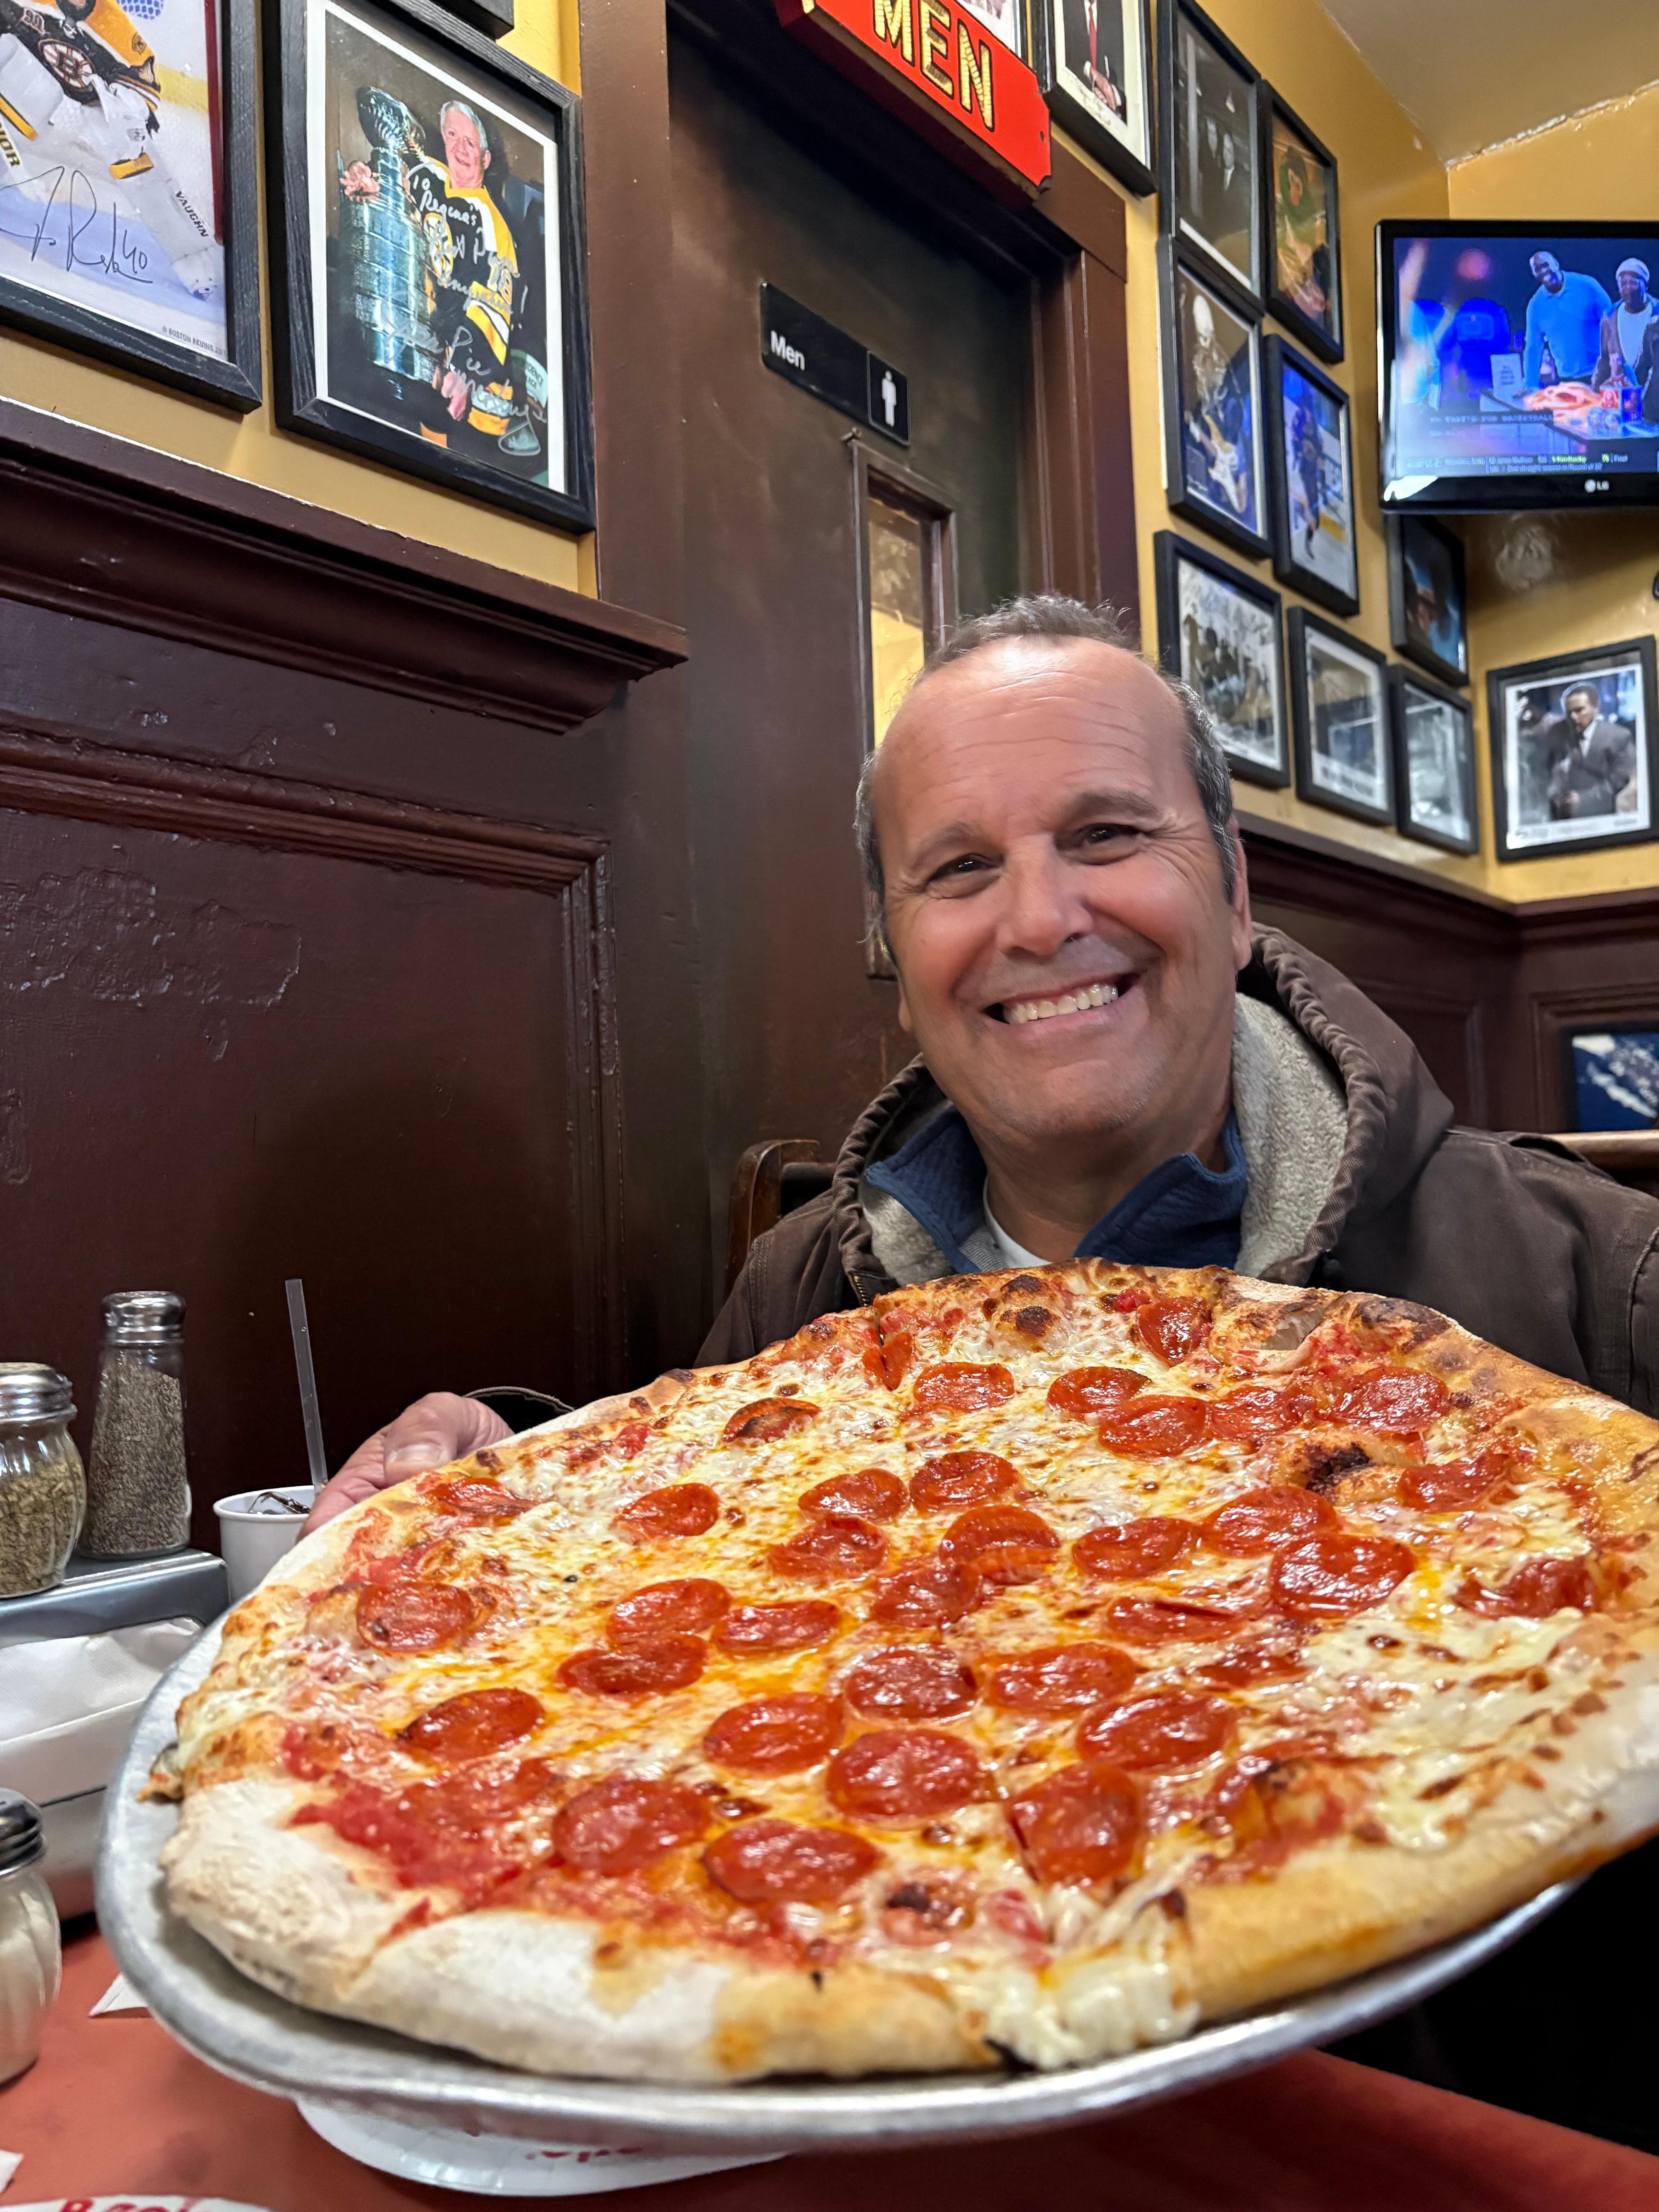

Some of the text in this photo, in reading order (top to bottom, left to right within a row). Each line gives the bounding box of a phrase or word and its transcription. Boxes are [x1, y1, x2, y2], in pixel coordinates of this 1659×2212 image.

[872, 0, 994, 132] MEN
[176, 191, 210, 237] VAUGHN
[168, 328, 192, 343] BOSTON
[192, 337, 214, 351] BRUINS
[771, 330, 805, 371] Men
